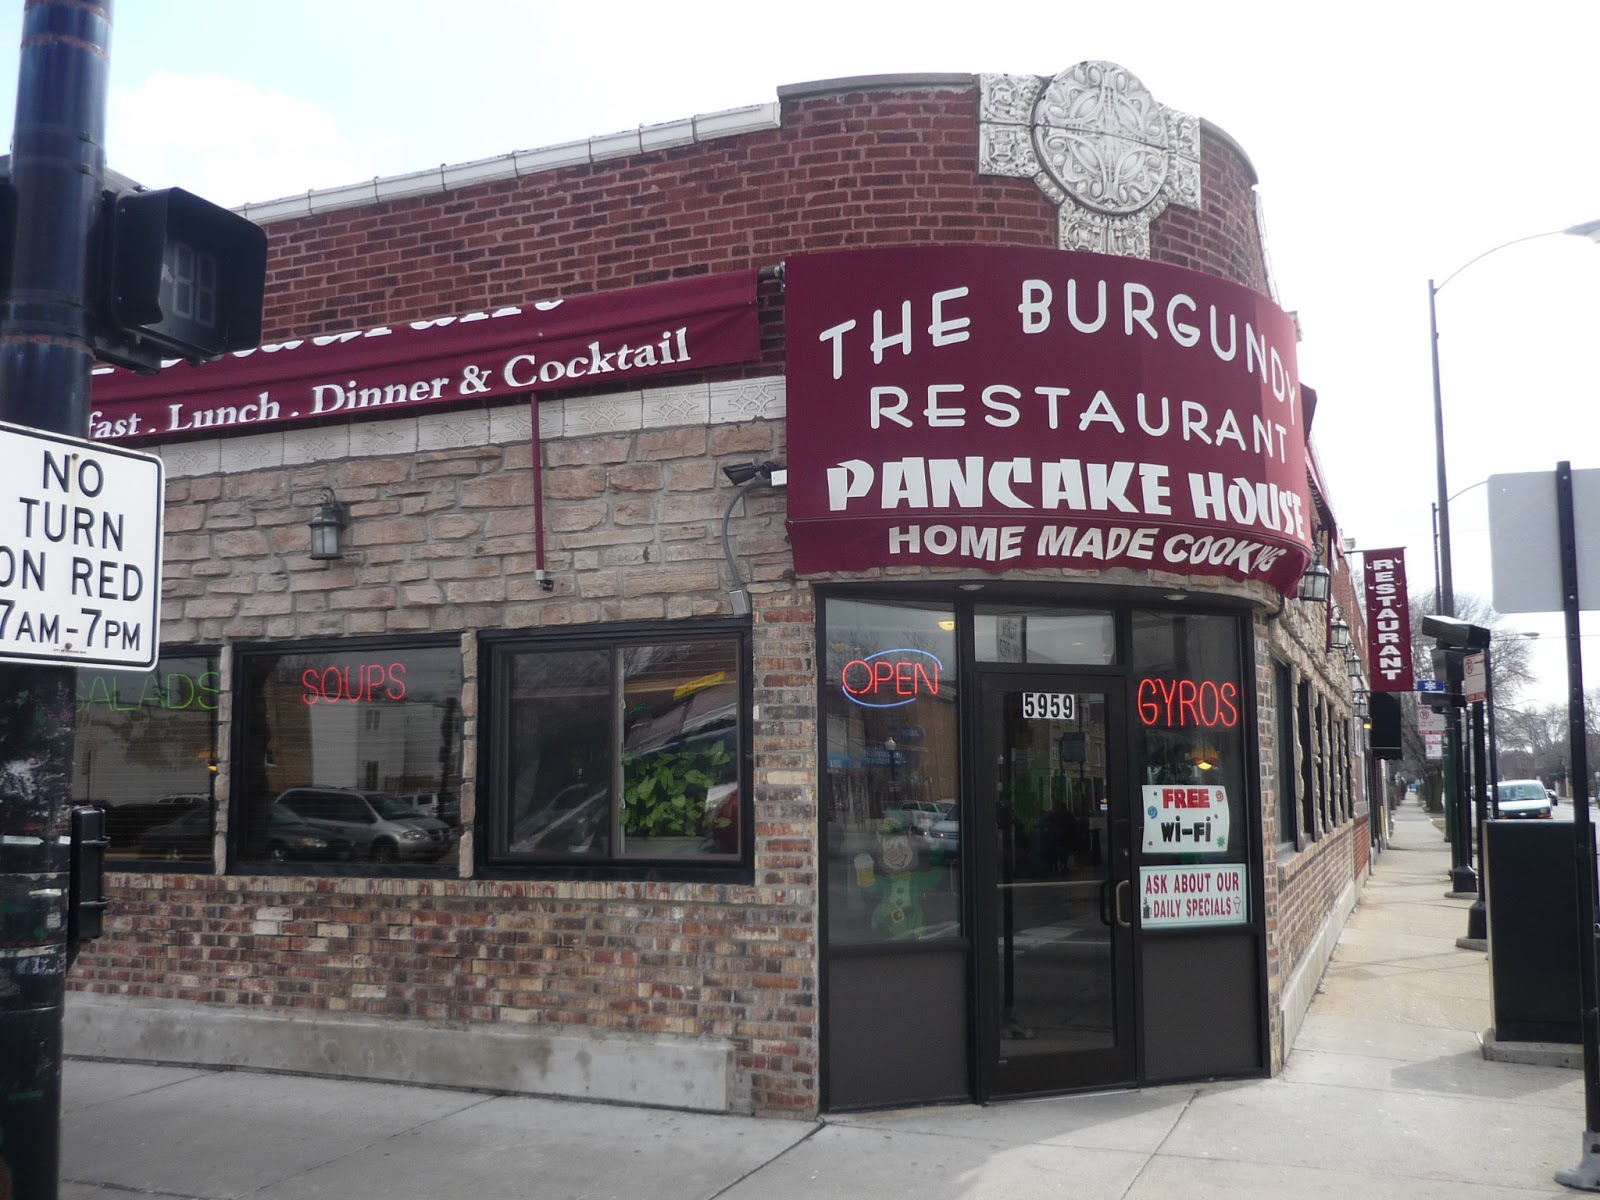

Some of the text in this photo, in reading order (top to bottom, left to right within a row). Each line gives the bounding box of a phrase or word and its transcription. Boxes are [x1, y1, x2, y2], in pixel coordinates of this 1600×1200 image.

[819, 279, 1296, 426] THE BURGUNDY
[166, 391, 281, 433] Lunch
[312, 377, 450, 415] Dinner
[459, 365, 493, 396] &
[503, 326, 691, 388] Cocktail
[870, 384, 1287, 463] RESTAURANT
[42, 450, 104, 498] NO
[827, 456, 1305, 541] PANCAKE HOUSE
[19, 496, 125, 552] TURN
[888, 524, 1027, 562] HOME
[1037, 526, 1160, 561] MADE
[0, 545, 144, 602] ON RED
[1372, 559, 1402, 681] RESTAURANT
[302, 662, 407, 706] SOUPS
[842, 660, 940, 696] OPEN
[1024, 693, 1074, 719] 5959
[1137, 678, 1238, 728] GYROS
[1162, 788, 1210, 809] FREE
[1145, 872, 1240, 895] ASK ABOUT OUR
[1153, 896, 1232, 919] DAILY SPECIALS
